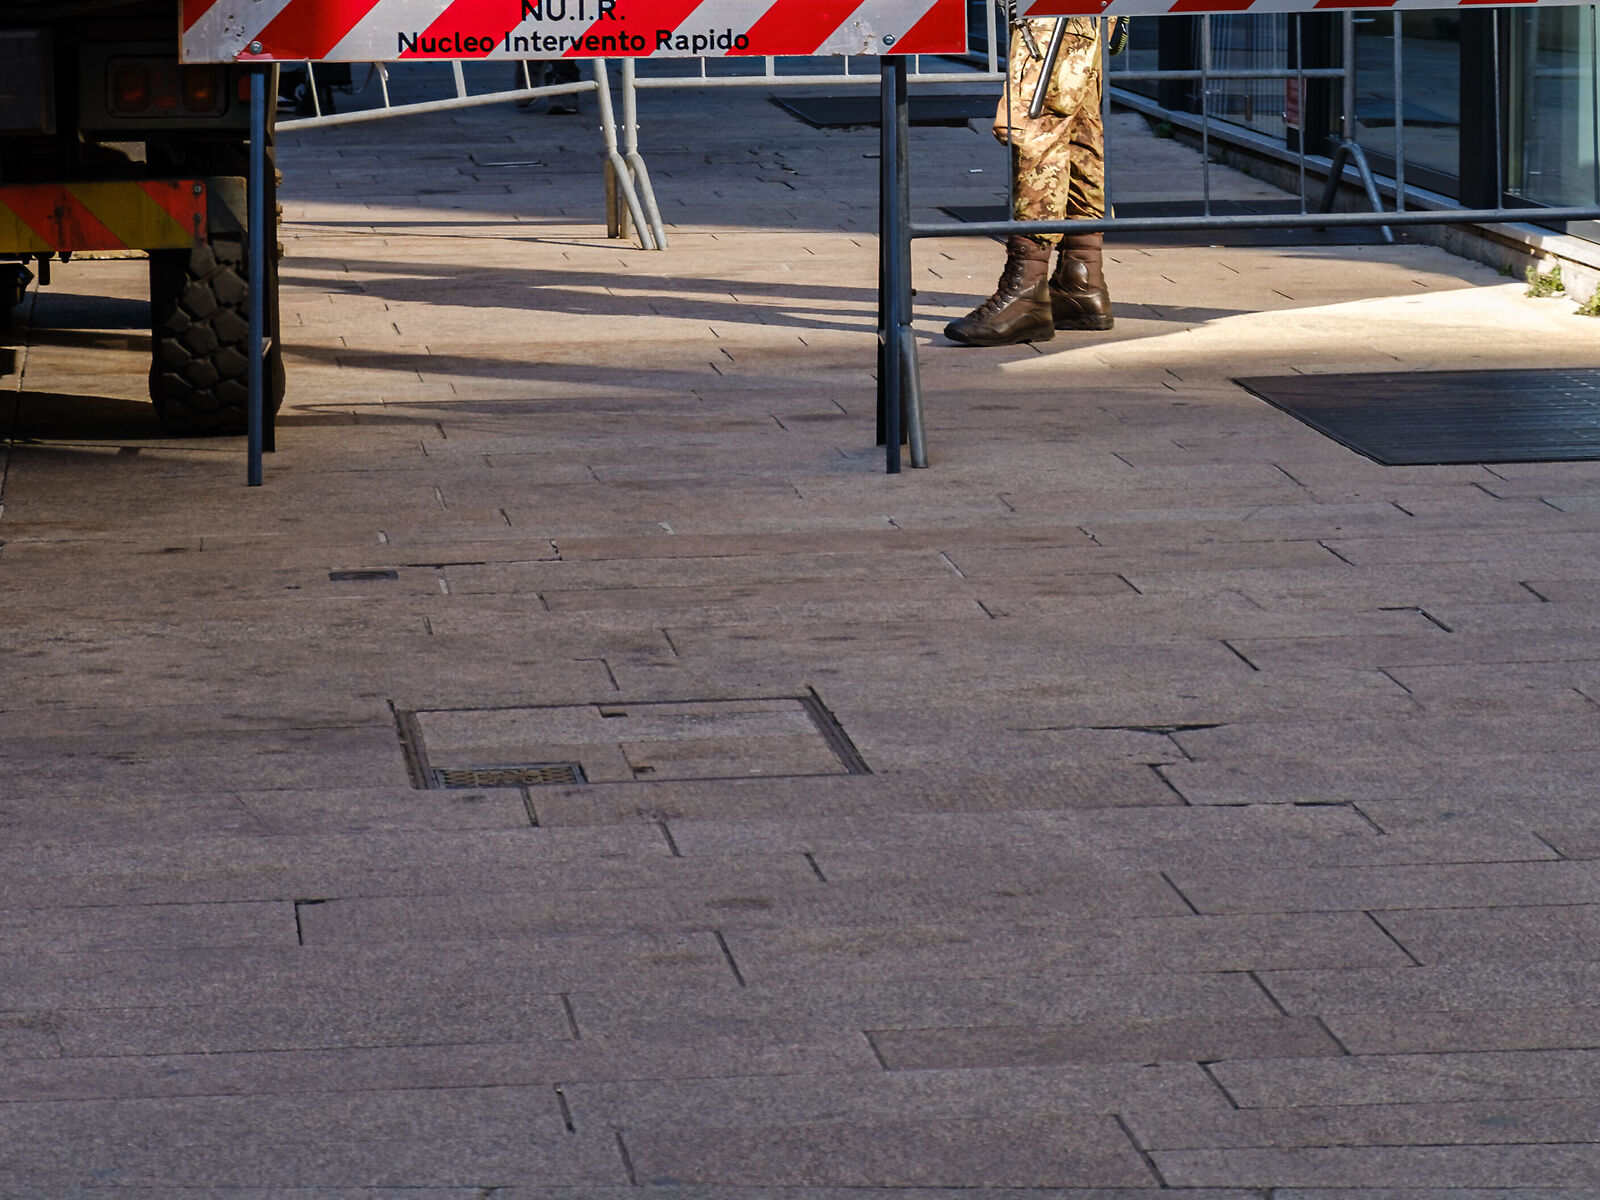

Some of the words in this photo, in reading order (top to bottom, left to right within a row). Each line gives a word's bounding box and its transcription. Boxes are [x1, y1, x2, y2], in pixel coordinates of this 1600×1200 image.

[397, 31, 496, 54] Nucleo
[504, 30, 646, 53] Intervento
[656, 28, 750, 55] Rapido
